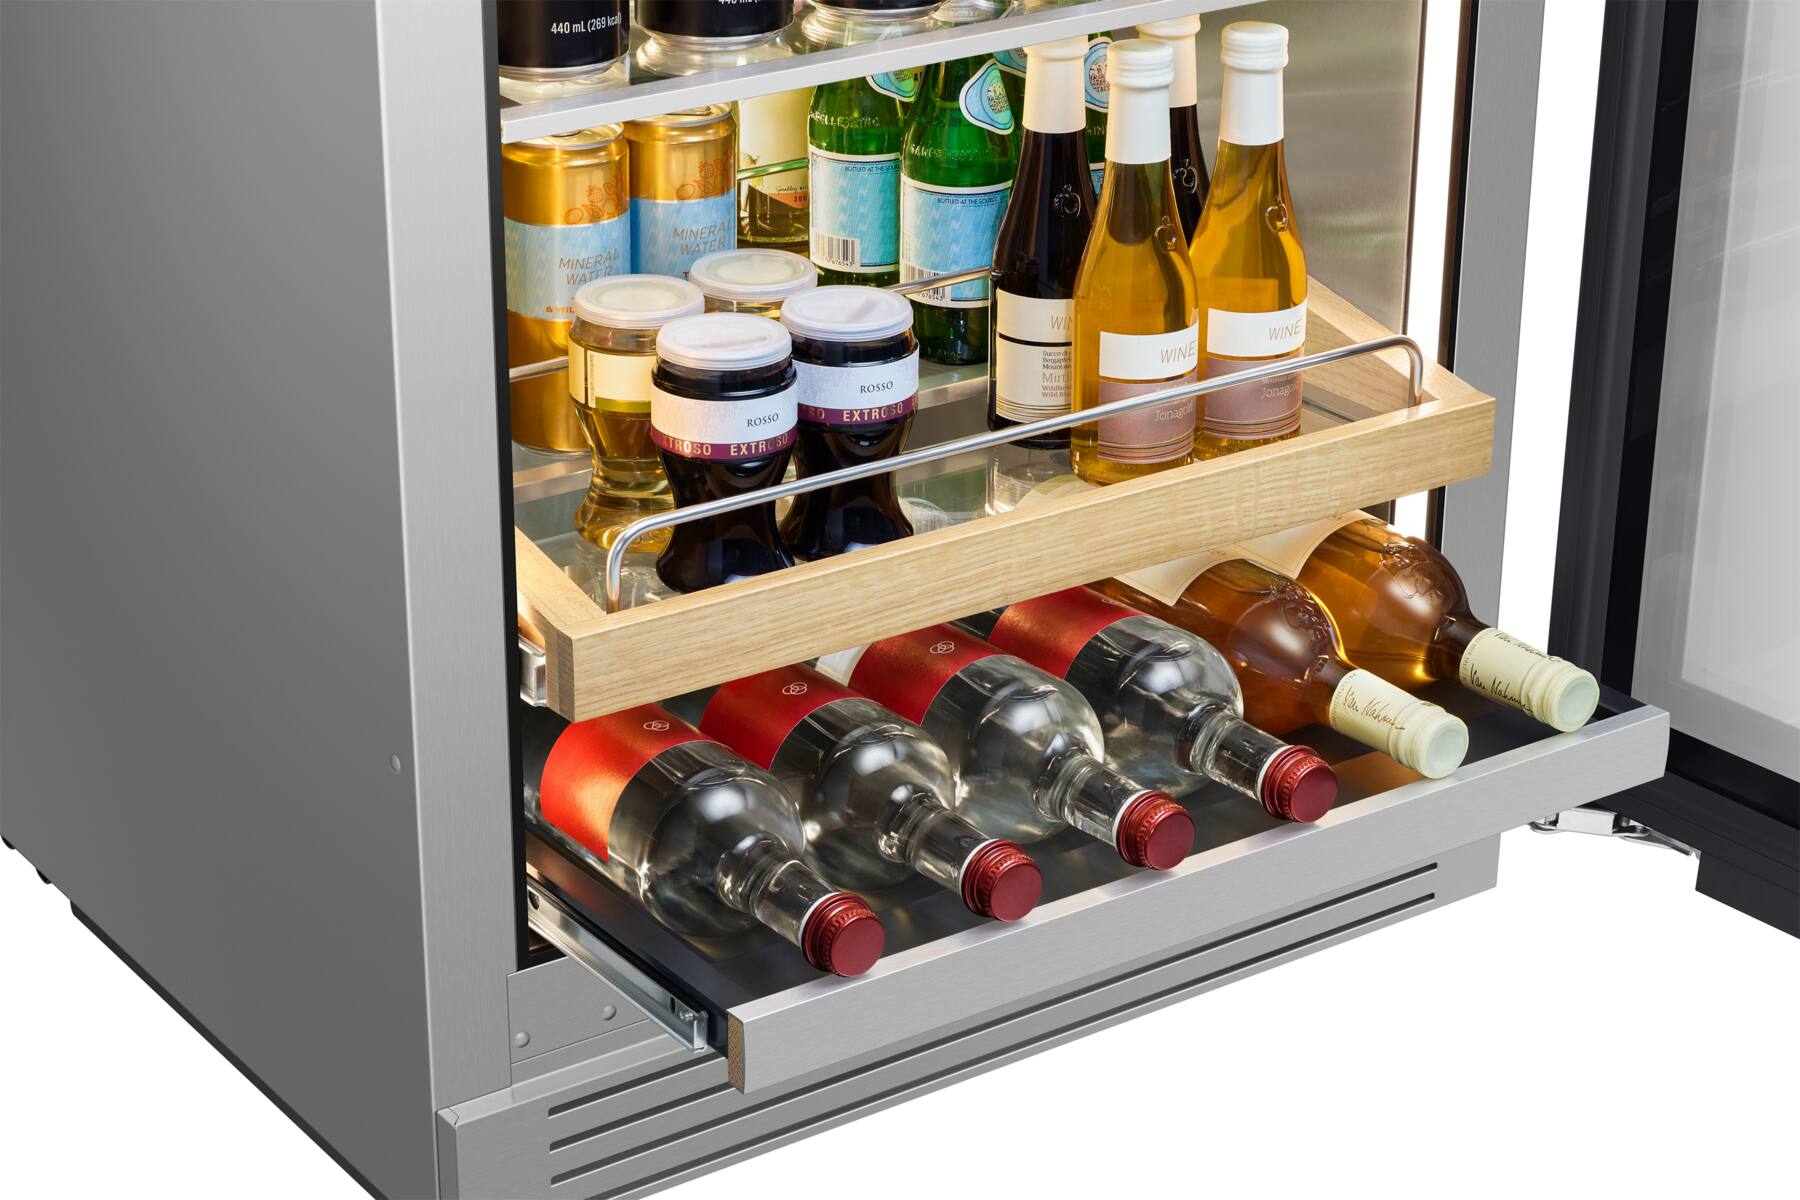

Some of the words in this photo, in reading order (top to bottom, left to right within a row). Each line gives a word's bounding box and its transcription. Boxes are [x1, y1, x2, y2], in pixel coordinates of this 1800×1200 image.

[550, 22, 570, 34] 440
[572, 20, 586, 33] mL
[587, 16, 606, 32] (269
[607, 11, 622, 27] kcal)
[672, 217, 734, 241] MINERAL
[681, 234, 729, 256] WATER
[558, 247, 620, 270] MINERAL
[566, 265, 613, 285] WATER
[1050, 314, 1073, 331] WIN
[1268, 318, 1304, 341] WINE
[1160, 338, 1198, 363] WINE
[859, 380, 894, 394] ROSSO
[746, 412, 779, 428] ROSSO
[843, 402, 903, 422] EXTROSO
